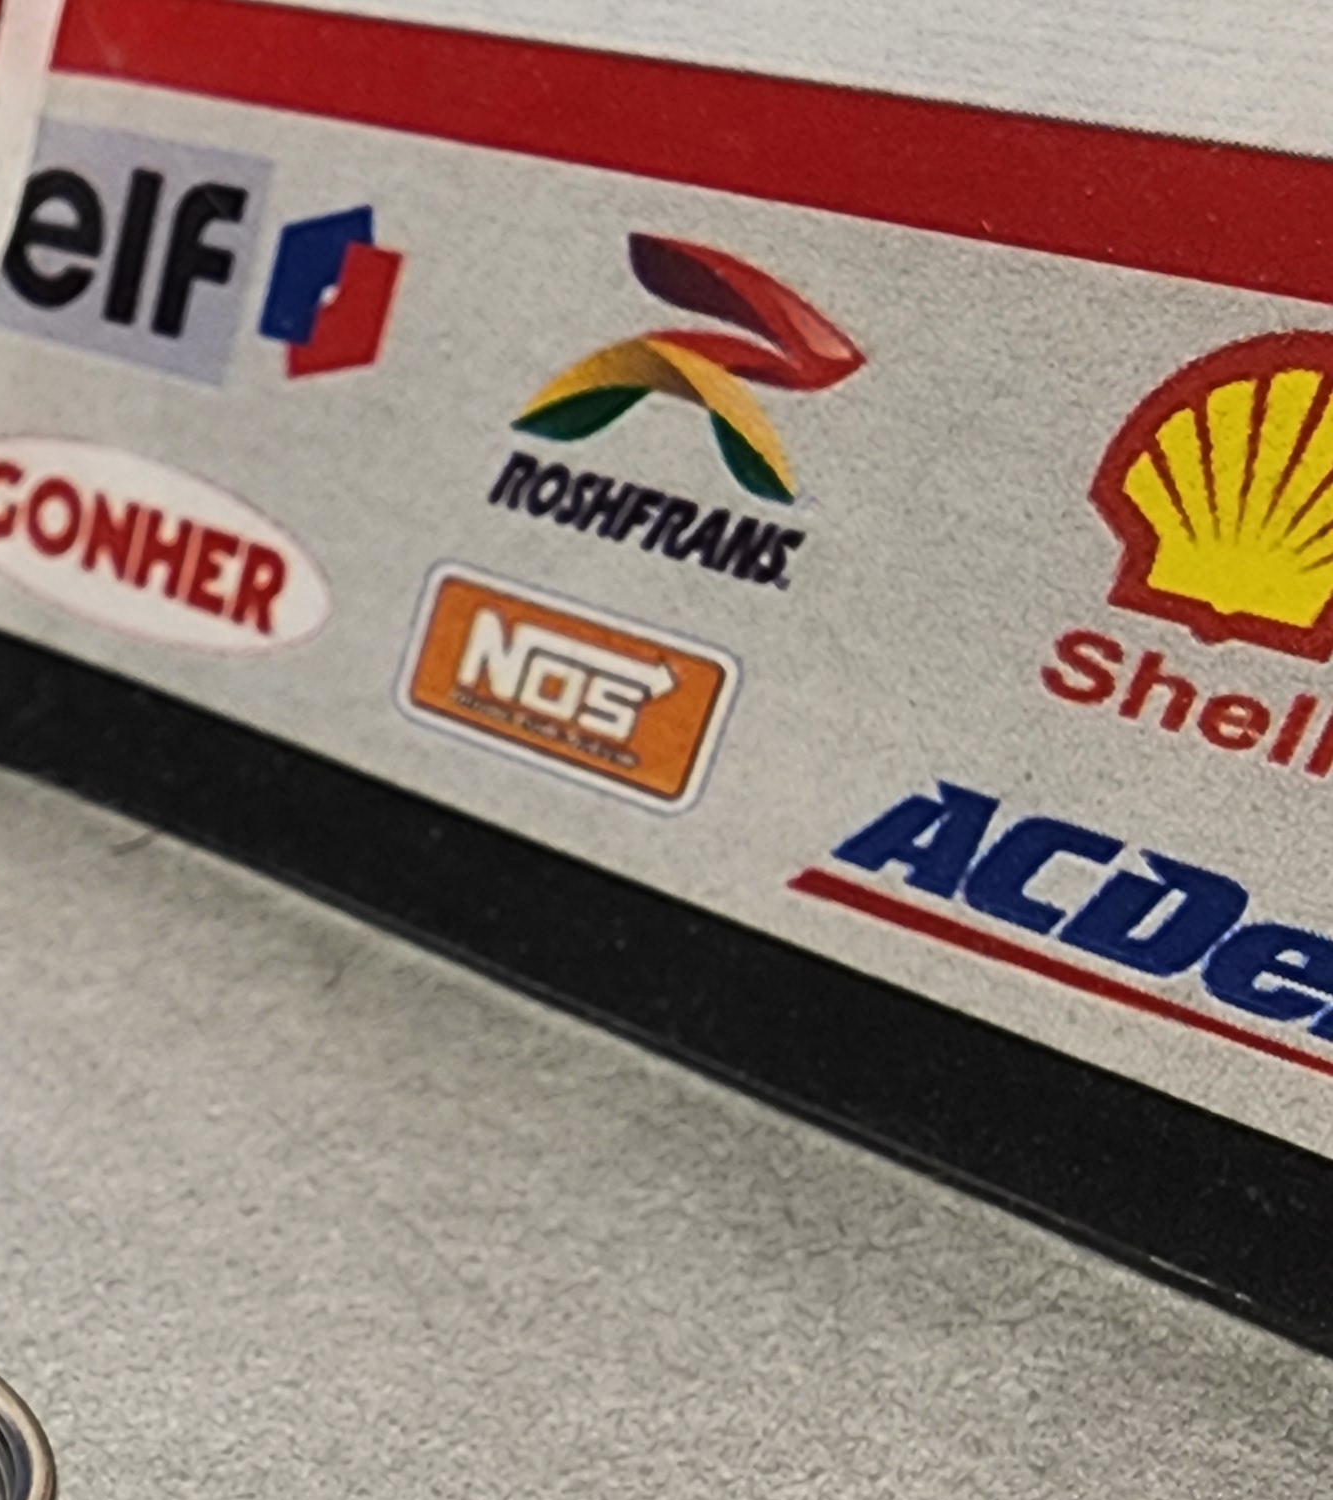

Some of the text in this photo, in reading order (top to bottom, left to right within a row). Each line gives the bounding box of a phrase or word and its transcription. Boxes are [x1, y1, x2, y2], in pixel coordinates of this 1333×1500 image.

[2, 168, 249, 339] elf
[488, 451, 806, 584] ROSHFRANS
[457, 608, 674, 743] NOS
[830, 780, 1333, 1043] ACDe
